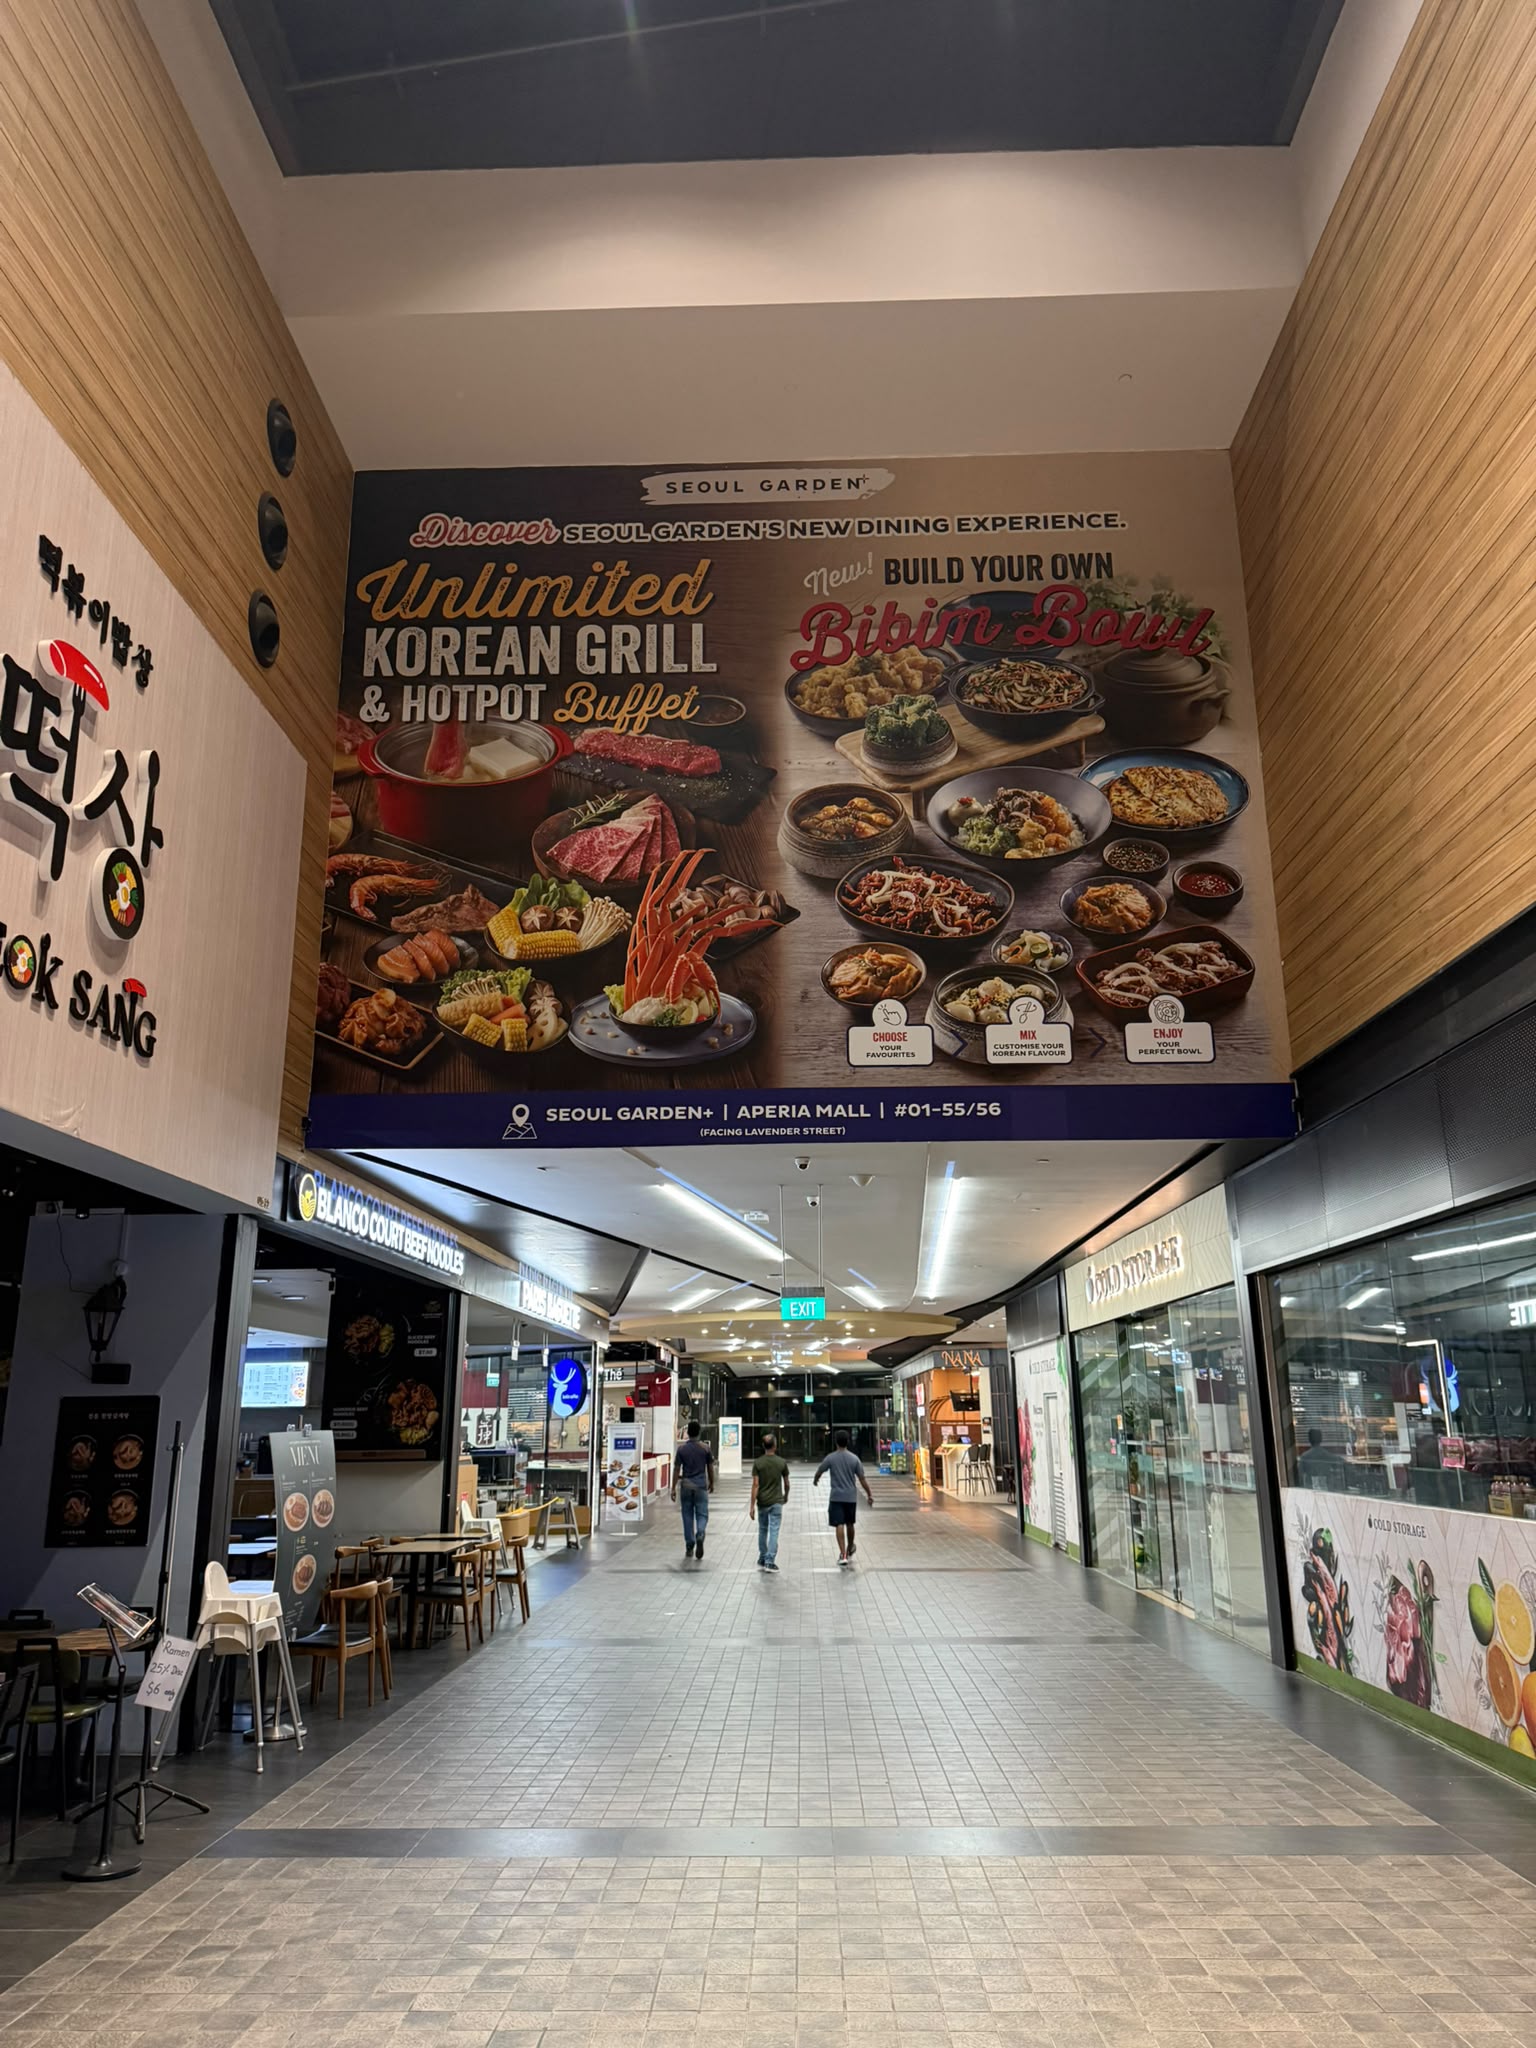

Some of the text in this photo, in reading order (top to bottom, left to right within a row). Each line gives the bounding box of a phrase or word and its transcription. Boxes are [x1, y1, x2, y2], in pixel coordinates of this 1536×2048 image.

[666, 481, 744, 494] SEOUL
[411, 512, 1127, 547] Discover SEOUL GARDEN'S NEW DINING EXPERIENCE.
[804, 552, 1114, 596] New! BUILD YOUR OWN
[356, 558, 715, 622] Unlimited
[790, 584, 1215, 671] Bibim Bowl
[363, 624, 717, 677] KOREAN GRILL
[359, 681, 700, 734] & HOTPOT Buffet
[70, 970, 157, 1058] SANG
[872, 1032, 908, 1043] CHOOSE
[1019, 1030, 1037, 1041] MIX
[1153, 1028, 1183, 1039] ENJOY
[1042, 1042, 1064, 1050] YOUR
[1178, 1047, 1203, 1055] BOWL
[546, 1103, 1001, 1121] SEOUL GARDEN+ APERIA MALL #01-55/56
[700, 1126, 846, 1137] (FACING LAVENDER STREET)
[316, 1188, 464, 1276] BLANCO COURT BEEF NOODLES
[790, 1301, 817, 1318] EXIT
[1373, 1518, 1427, 1538] COLD STORAGE
[163, 1640, 190, 1657] Ramen
[150, 1662, 170, 1675] 25%
[146, 1681, 161, 1697] $6
